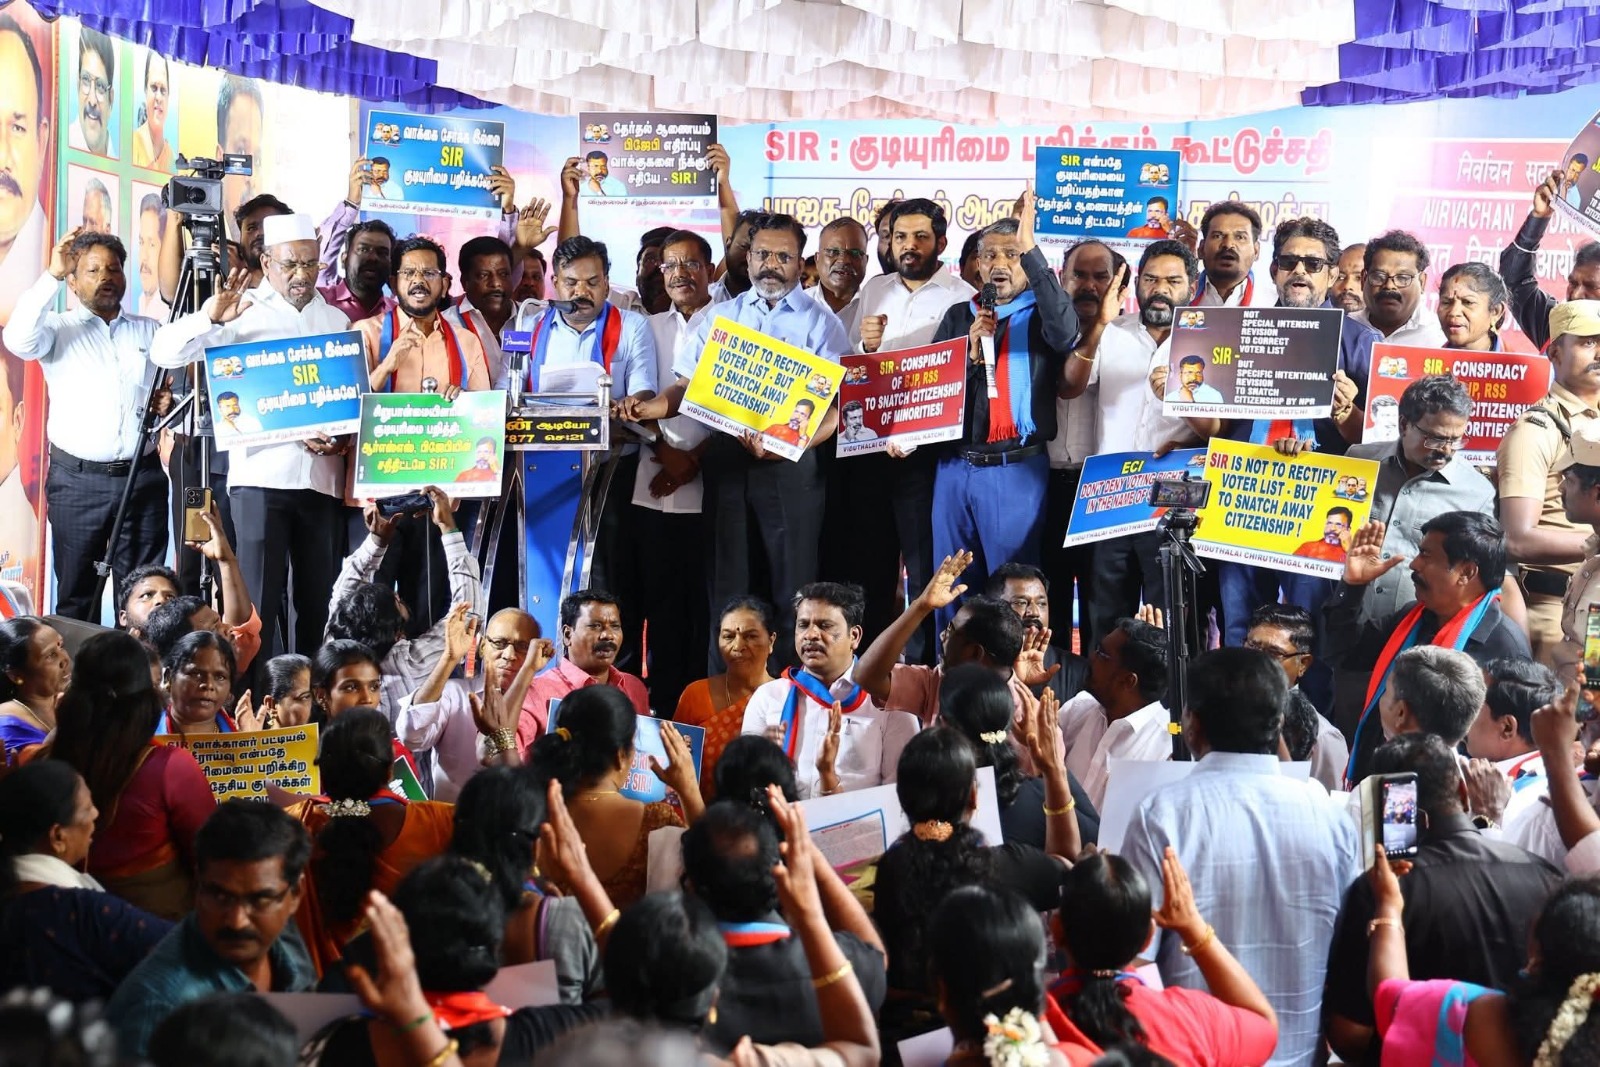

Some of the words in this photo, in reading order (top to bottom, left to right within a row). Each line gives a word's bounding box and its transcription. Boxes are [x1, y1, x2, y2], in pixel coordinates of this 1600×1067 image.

[613, 121, 652, 137] தேர்தல்
[655, 121, 711, 137] ஆணையம்
[623, 137, 660, 151] பிஜேபி
[663, 138, 701, 154] எதிர்ப்பு
[765, 131, 819, 162] SIR
[831, 138, 838, 161] :
[850, 125, 1010, 172] குடியுரிமை
[440, 146, 464, 167] SIR
[610, 154, 675, 168] வாக்குகளை
[1061, 154, 1080, 166] SIR
[1083, 155, 1122, 171] என்பதே
[1056, 169, 1125, 183] குடியுரிமையை
[1457, 150, 1513, 184] निर्वाचन
[628, 171, 661, 186] சதியே
[1056, 183, 1125, 198] பறிப்பதற்கான
[1038, 197, 1072, 212] தேர்தல்
[1075, 199, 1143, 216] ஆணையத்தின்
[1052, 214, 1082, 226] செயல்
[1422, 201, 1515, 231] NIRVACHAN
[1244, 310, 1259, 319] NOT
[1241, 328, 1278, 336] REVISION
[1242, 320, 1276, 329] SPECIAL
[1277, 320, 1320, 330] INTENSIVE
[1239, 345, 1266, 354] VOTER
[1267, 346, 1285, 355] LIST
[1240, 336, 1250, 344] TO
[1252, 336, 1289, 346] CORRECT
[711, 328, 728, 345] SIR
[728, 335, 739, 349] IS
[739, 339, 760, 358] NOT
[761, 348, 774, 364] TO
[773, 354, 813, 380] RECTIFY
[880, 360, 894, 376] SIR
[901, 350, 952, 372] CONSPIRACY
[1212, 347, 1232, 365] SIR
[718, 348, 747, 370] VOTER
[750, 361, 770, 380] LIST
[774, 372, 795, 390] BUT
[1238, 360, 1254, 368] BUT
[1423, 358, 1444, 375] SIR
[1453, 360, 1528, 380] CONSPIRACY
[292, 363, 320, 386] SIR
[892, 376, 902, 390] OF
[923, 369, 939, 385] RSS
[1236, 378, 1274, 387] REVISION
[1237, 369, 1273, 379] SPECIFIC
[1274, 370, 1328, 381] INTENTIONAL
[712, 363, 724, 379] TO
[725, 367, 762, 396] SNATCH
[760, 385, 789, 406] AWAY
[1235, 387, 1247, 396] TO
[1248, 388, 1279, 397] SNATCH
[1484, 384, 1507, 399] RSS
[714, 382, 770, 416] CITIZENSHIP
[865, 397, 876, 411] TO
[878, 390, 909, 409] SNATCH
[912, 381, 962, 404] CITIZENSHIP
[1234, 396, 1284, 405] CITIZENSHIP
[686, 405, 723, 426] VIDUTHALAI
[881, 412, 892, 426] OF
[429, 458, 448, 470] SIR
[1121, 460, 1145, 475] ECI
[1209, 452, 1229, 470] SIR
[1231, 455, 1243, 472] IS
[1245, 458, 1268, 474] NOT
[1272, 462, 1286, 477] TO
[1288, 465, 1337, 485] RECTIFY
[1104, 477, 1125, 494] DENY
[1126, 472, 1156, 489] VOTING
[1222, 473, 1256, 492] VOTER
[1260, 479, 1285, 496] LIST
[1294, 484, 1318, 501] BUT
[1085, 499, 1096, 514] IN
[1096, 495, 1113, 512] THE
[1112, 491, 1134, 509] NAME
[1135, 489, 1146, 504] OF
[1218, 491, 1232, 508] TO
[1235, 494, 1278, 514] SNATCH
[1281, 503, 1314, 520] AWAY
[1225, 512, 1295, 536] CITIZENSHIP
[1197, 544, 1242, 558] VIDUTHALAI
[1244, 551, 1302, 568] CHIRUTHAIGAL
[1304, 561, 1334, 573] KATCHI
[193, 739, 256, 749] வாக்காளர்
[262, 731, 306, 745] பட்டியல்
[239, 747, 285, 759] என்பதே
[258, 760, 306, 776] பறிக்கிற
[632, 773, 647, 792] SIR
